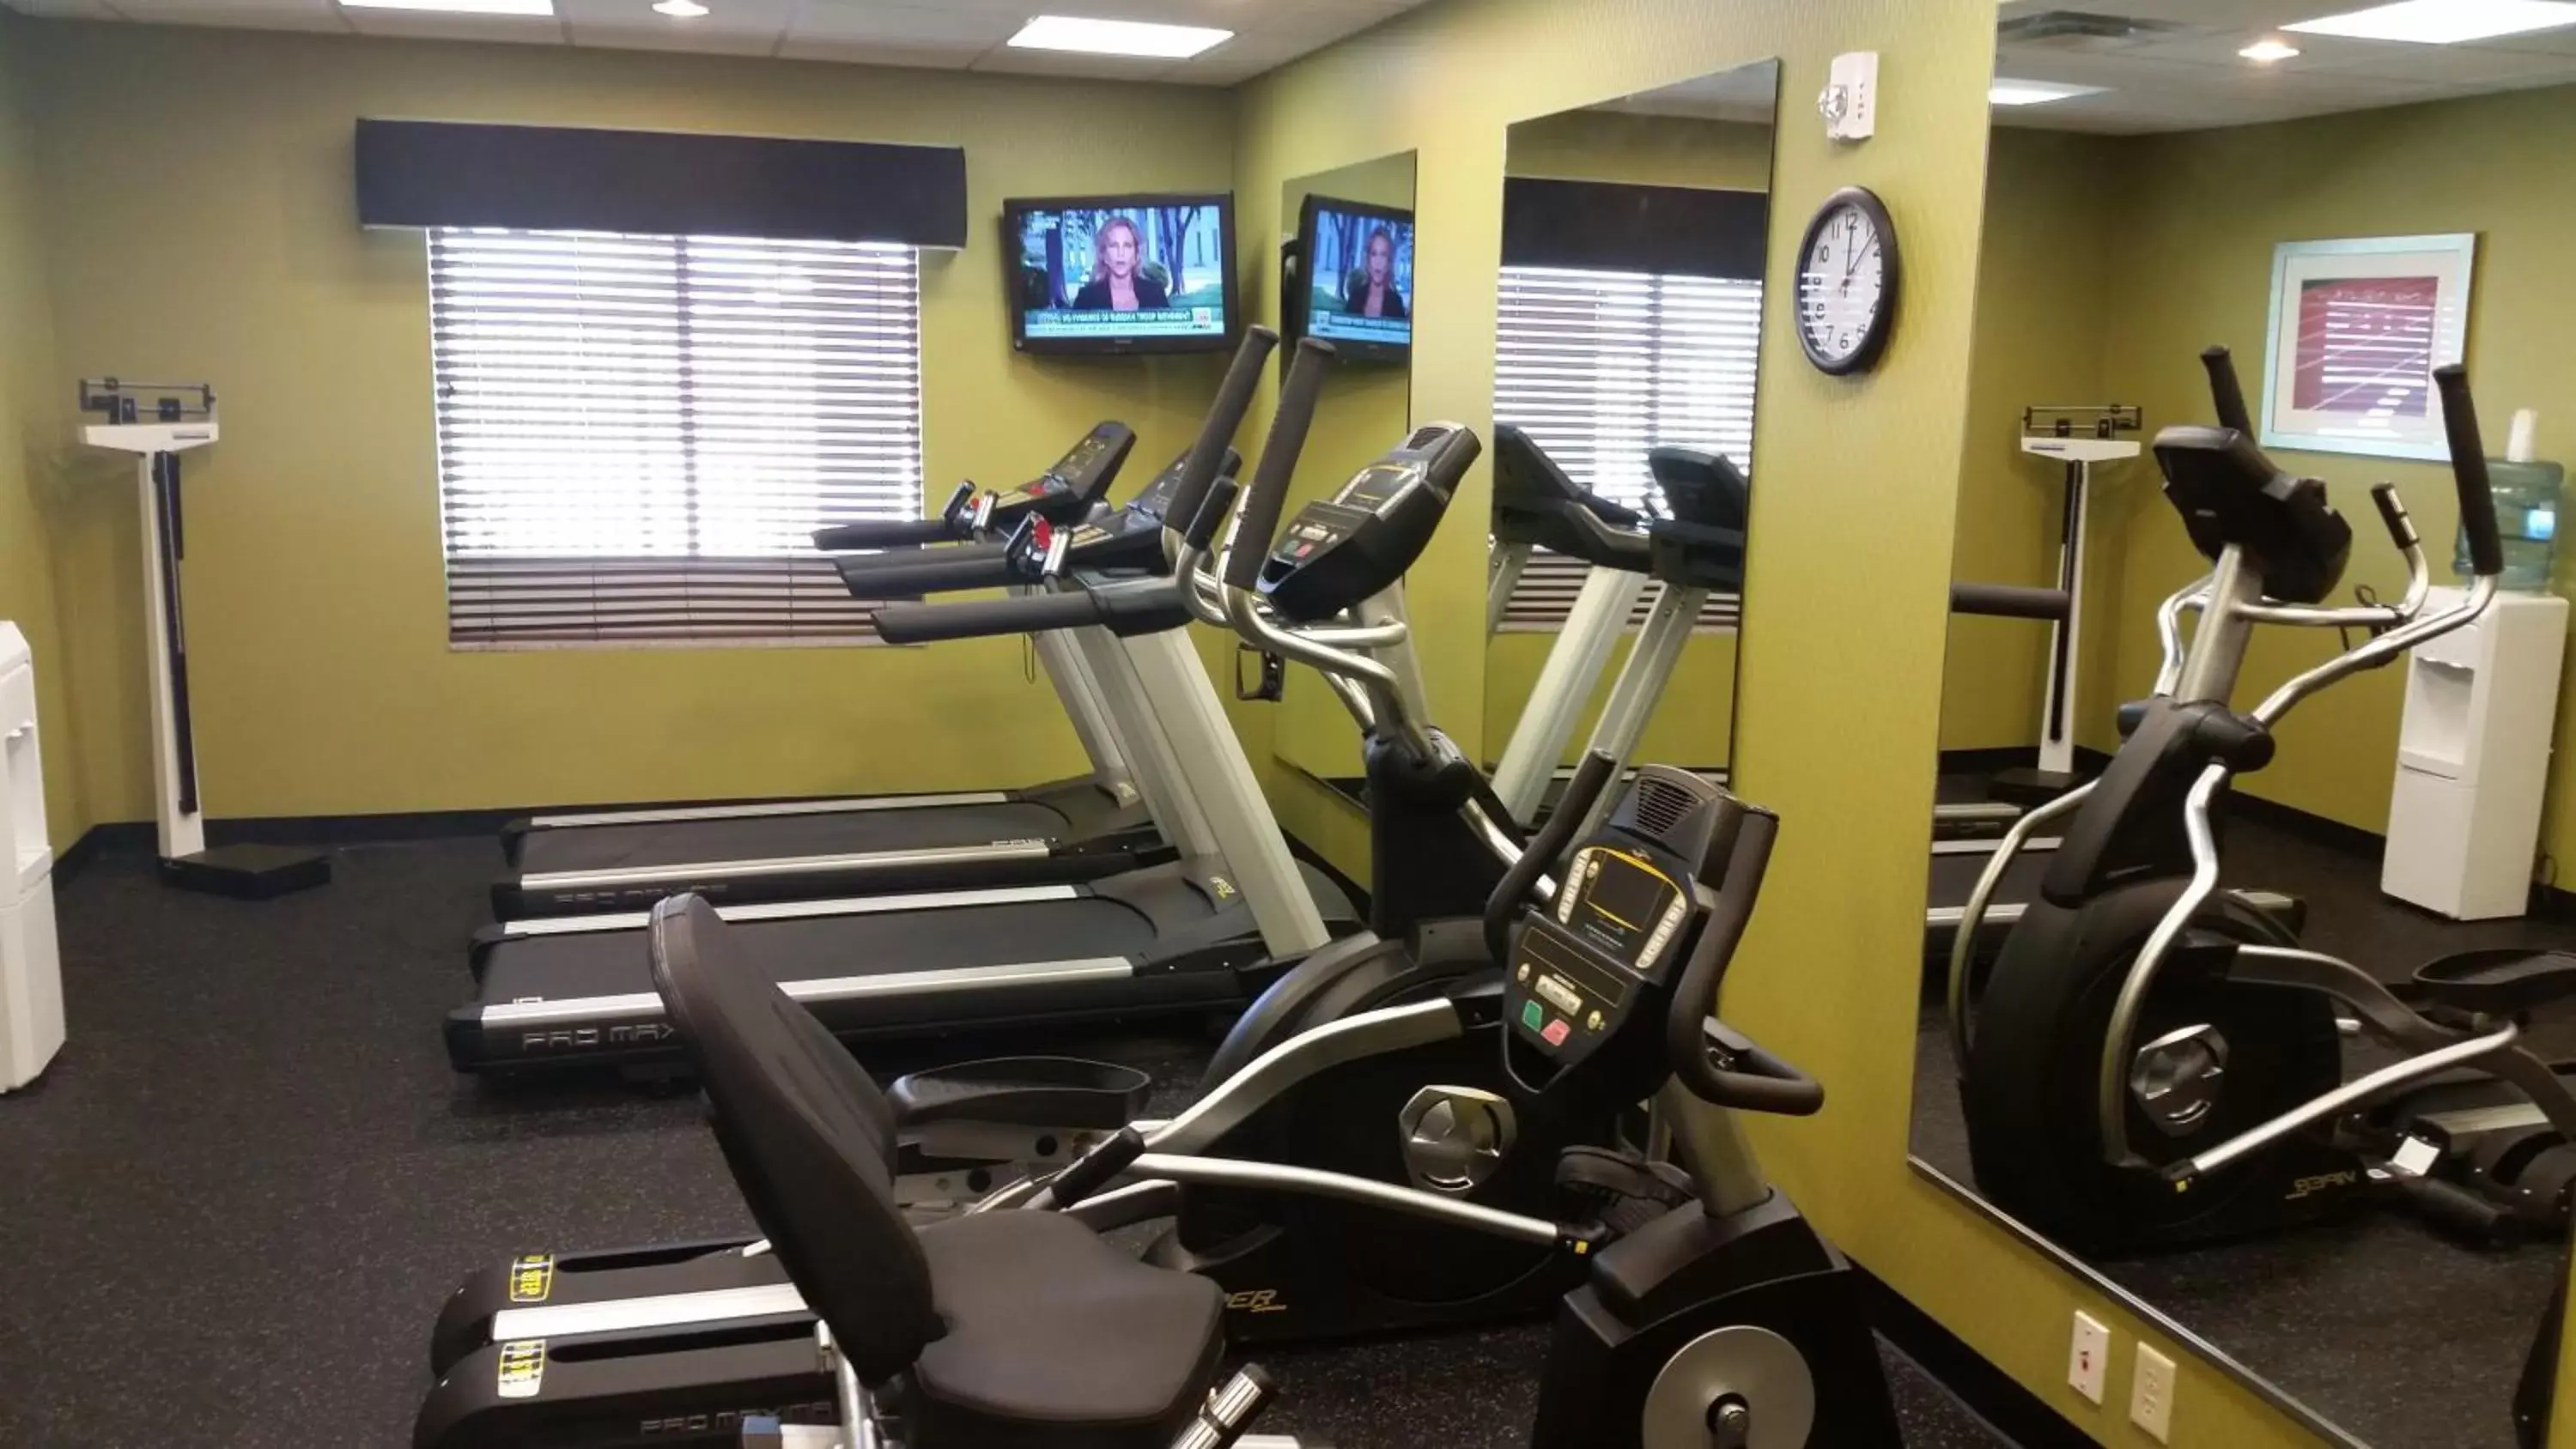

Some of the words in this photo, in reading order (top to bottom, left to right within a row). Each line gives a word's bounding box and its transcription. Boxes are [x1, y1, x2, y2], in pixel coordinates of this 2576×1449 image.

[1845, 212, 1859, 231] 12
[1832, 222, 1841, 240] 11
[1818, 245, 1830, 263] 10
[1815, 303, 1826, 319] 8
[1826, 324, 1834, 342] 7
[1839, 332, 1849, 349] 6
[522, 1028, 599, 1052] PRO
